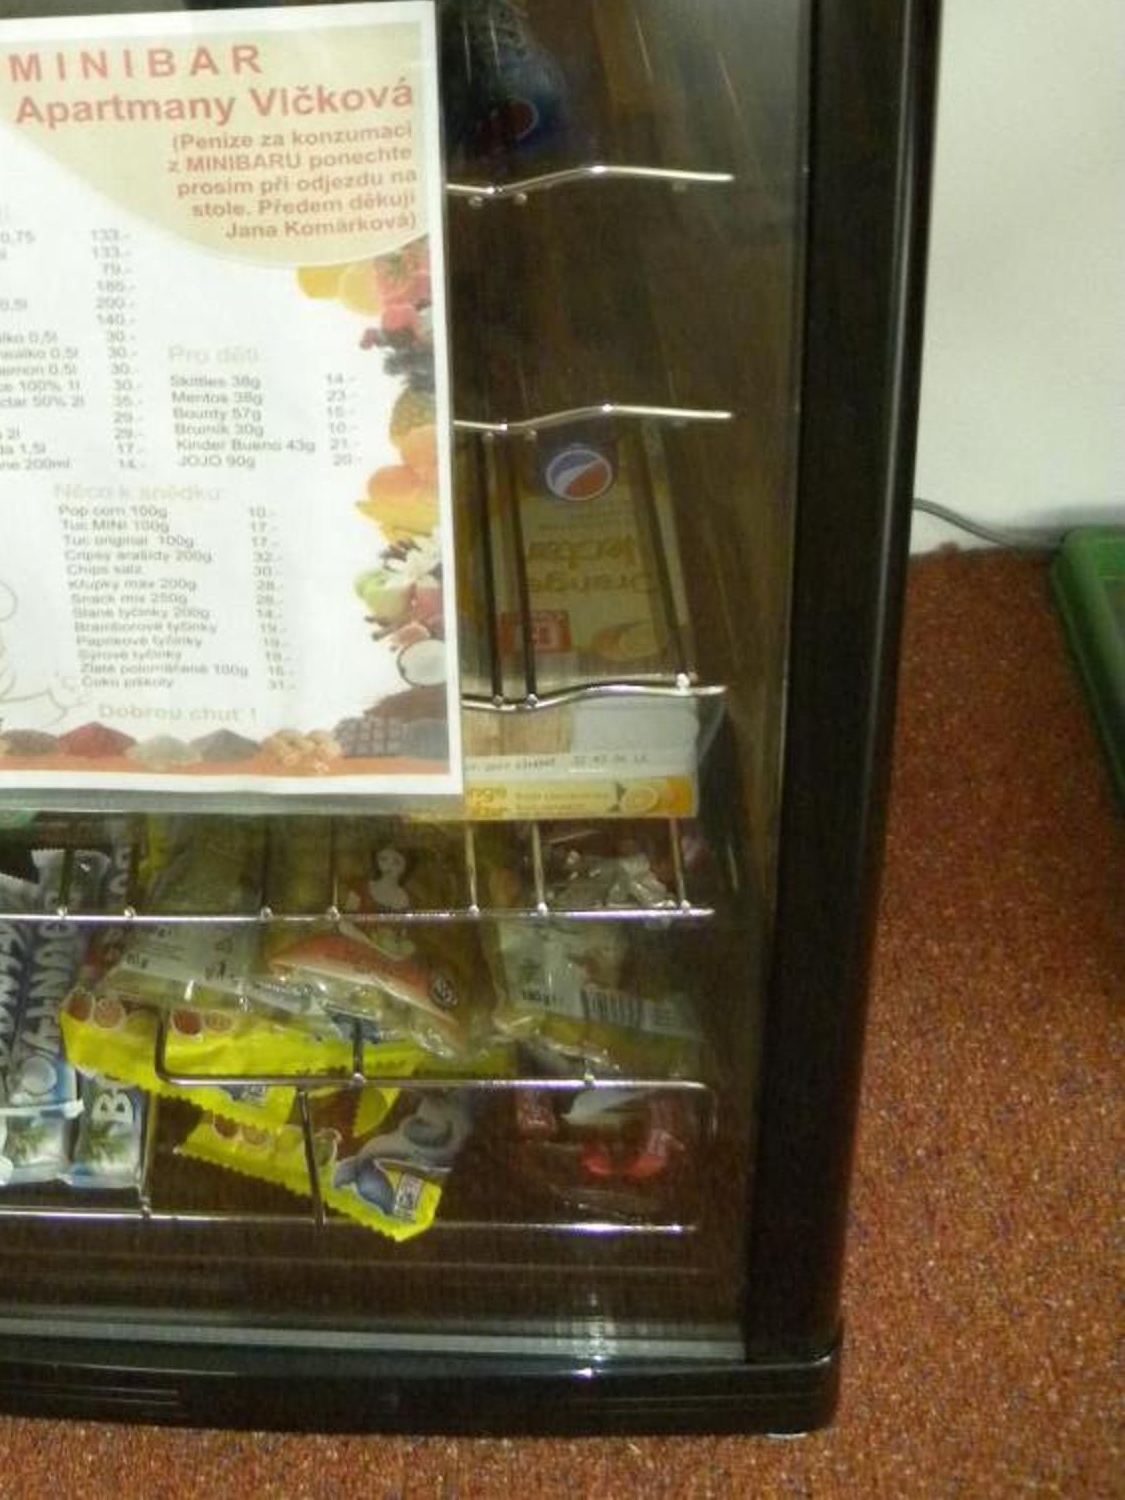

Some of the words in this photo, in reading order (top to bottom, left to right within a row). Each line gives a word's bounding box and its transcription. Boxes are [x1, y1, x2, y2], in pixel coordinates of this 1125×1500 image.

[8, 43, 263, 82] MINIBAR
[14, 94, 237, 130] Apartmany
[249, 74, 414, 119] Vlčková
[261, 132, 285, 149] za
[168, 159, 180, 174] z
[186, 150, 302, 174] MINIBARU
[309, 145, 413, 171] ponechte
[296, 171, 383, 195] odjezdu
[391, 168, 417, 185] na
[192, 200, 251, 218] stole.
[258, 195, 343, 216] Předem
[225, 221, 278, 240] Jana
